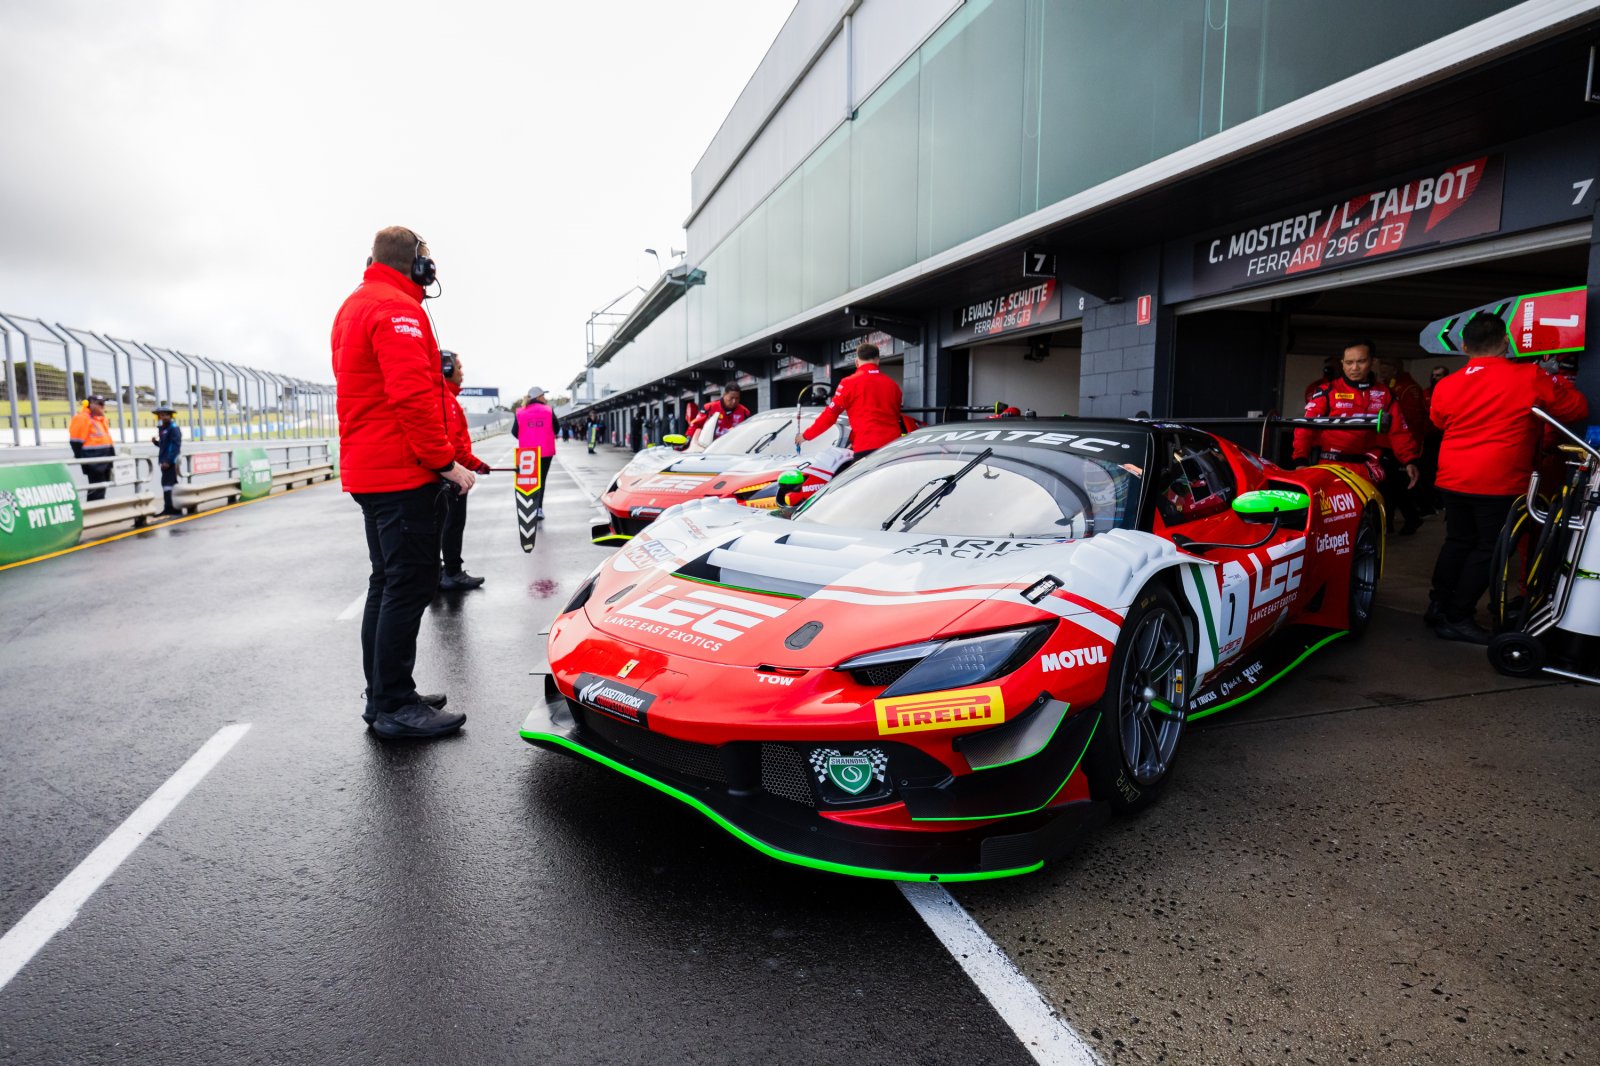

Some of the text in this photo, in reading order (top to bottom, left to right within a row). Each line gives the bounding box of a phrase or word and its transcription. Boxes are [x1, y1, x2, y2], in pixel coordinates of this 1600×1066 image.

[1572, 178, 1595, 206] 7
[1209, 239, 1223, 264] C.
[1228, 210, 1322, 259] MOSTERT
[1340, 200, 1361, 231] L.
[1370, 165, 1476, 222] TALBOT
[1033, 253, 1047, 272] 7
[1246, 222, 1403, 278] FERRARI 296 GT3
[961, 307, 968, 327] J.
[968, 299, 993, 323] EVANS
[999, 296, 1007, 313] E.
[1008, 283, 1048, 311] SCHUTTE
[1078, 297, 1085, 311] 8
[974, 308, 1031, 335] FERRARI 296 GT3
[1521, 301, 1535, 348] ENGINE OFF
[1539, 314, 1580, 328] 1
[775, 343, 783, 353] 9
[723, 360, 735, 368] 10
[519, 450, 536, 475] 8
[15, 481, 77, 509] SHANNONS
[1328, 493, 1355, 512] VGW
[27, 502, 76, 529] PIT LANE
[1316, 530, 1350, 553] CarExpert
[1228, 593, 1236, 635] 1
[1249, 592, 1298, 624] LANCE EAST EXOTICS
[604, 615, 724, 652] LANCE EAST EXOTICS
[1041, 645, 1107, 673] MOTUL
[757, 673, 795, 686] TOW
[596, 696, 638, 717] COMPETIZIONE
[1196, 690, 1218, 706] TRUCKS
[885, 695, 992, 729] PIRELLI
[829, 757, 868, 766] SHANNONS
